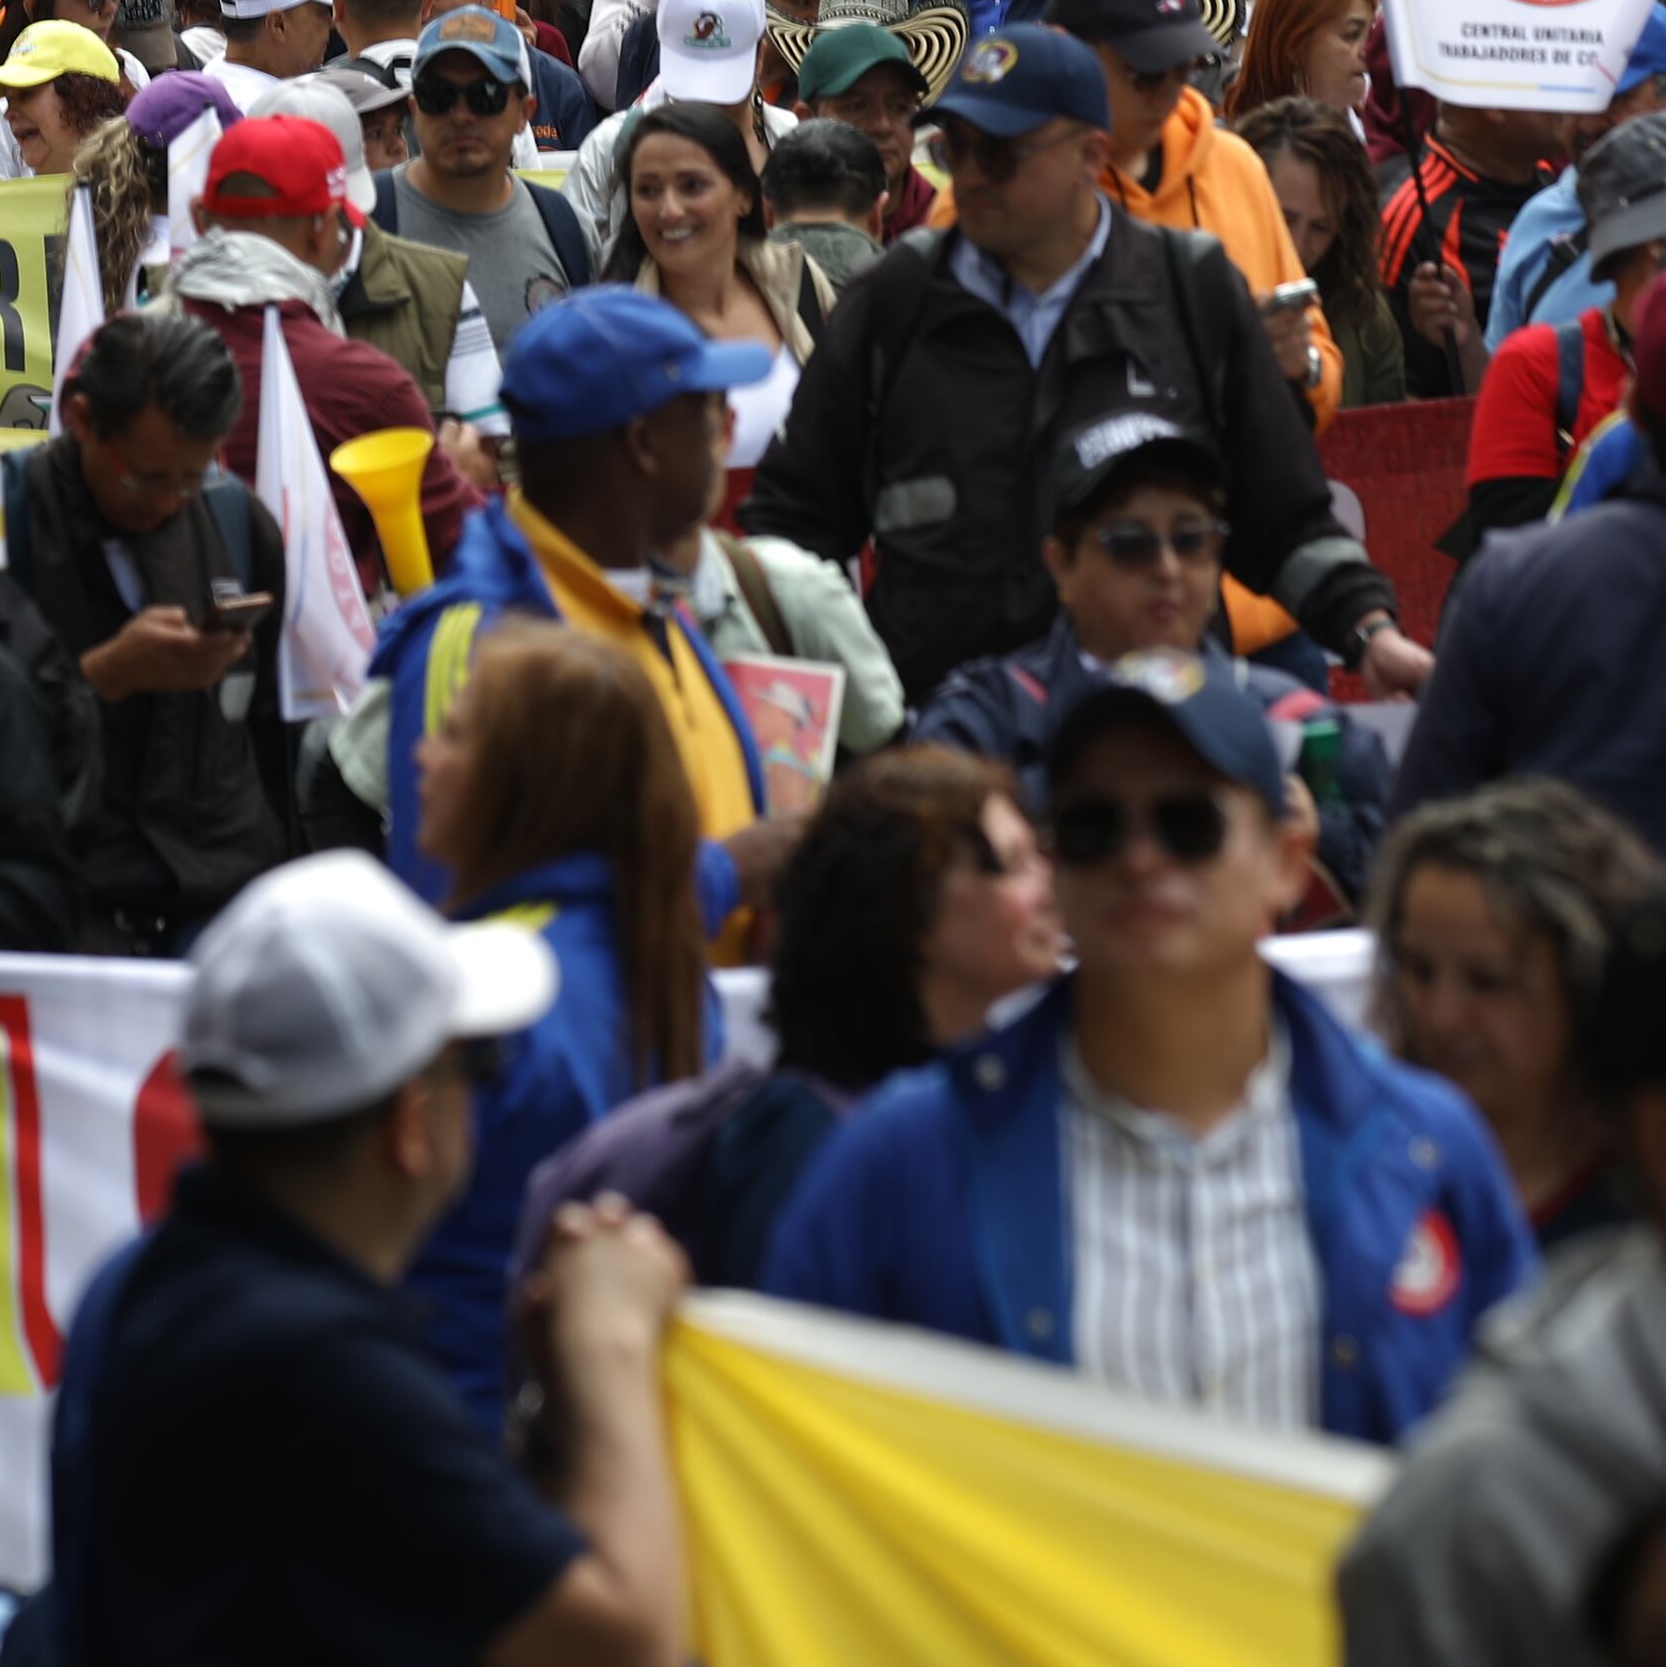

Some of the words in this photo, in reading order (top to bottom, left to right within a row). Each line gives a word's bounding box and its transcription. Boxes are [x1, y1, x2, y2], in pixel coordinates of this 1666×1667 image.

[1461, 22, 1527, 41] CENTRAL
[1533, 24, 1604, 45] UNITARIA
[1438, 42, 1548, 65] TRABAJADORES
[1553, 51, 1571, 65] DE
